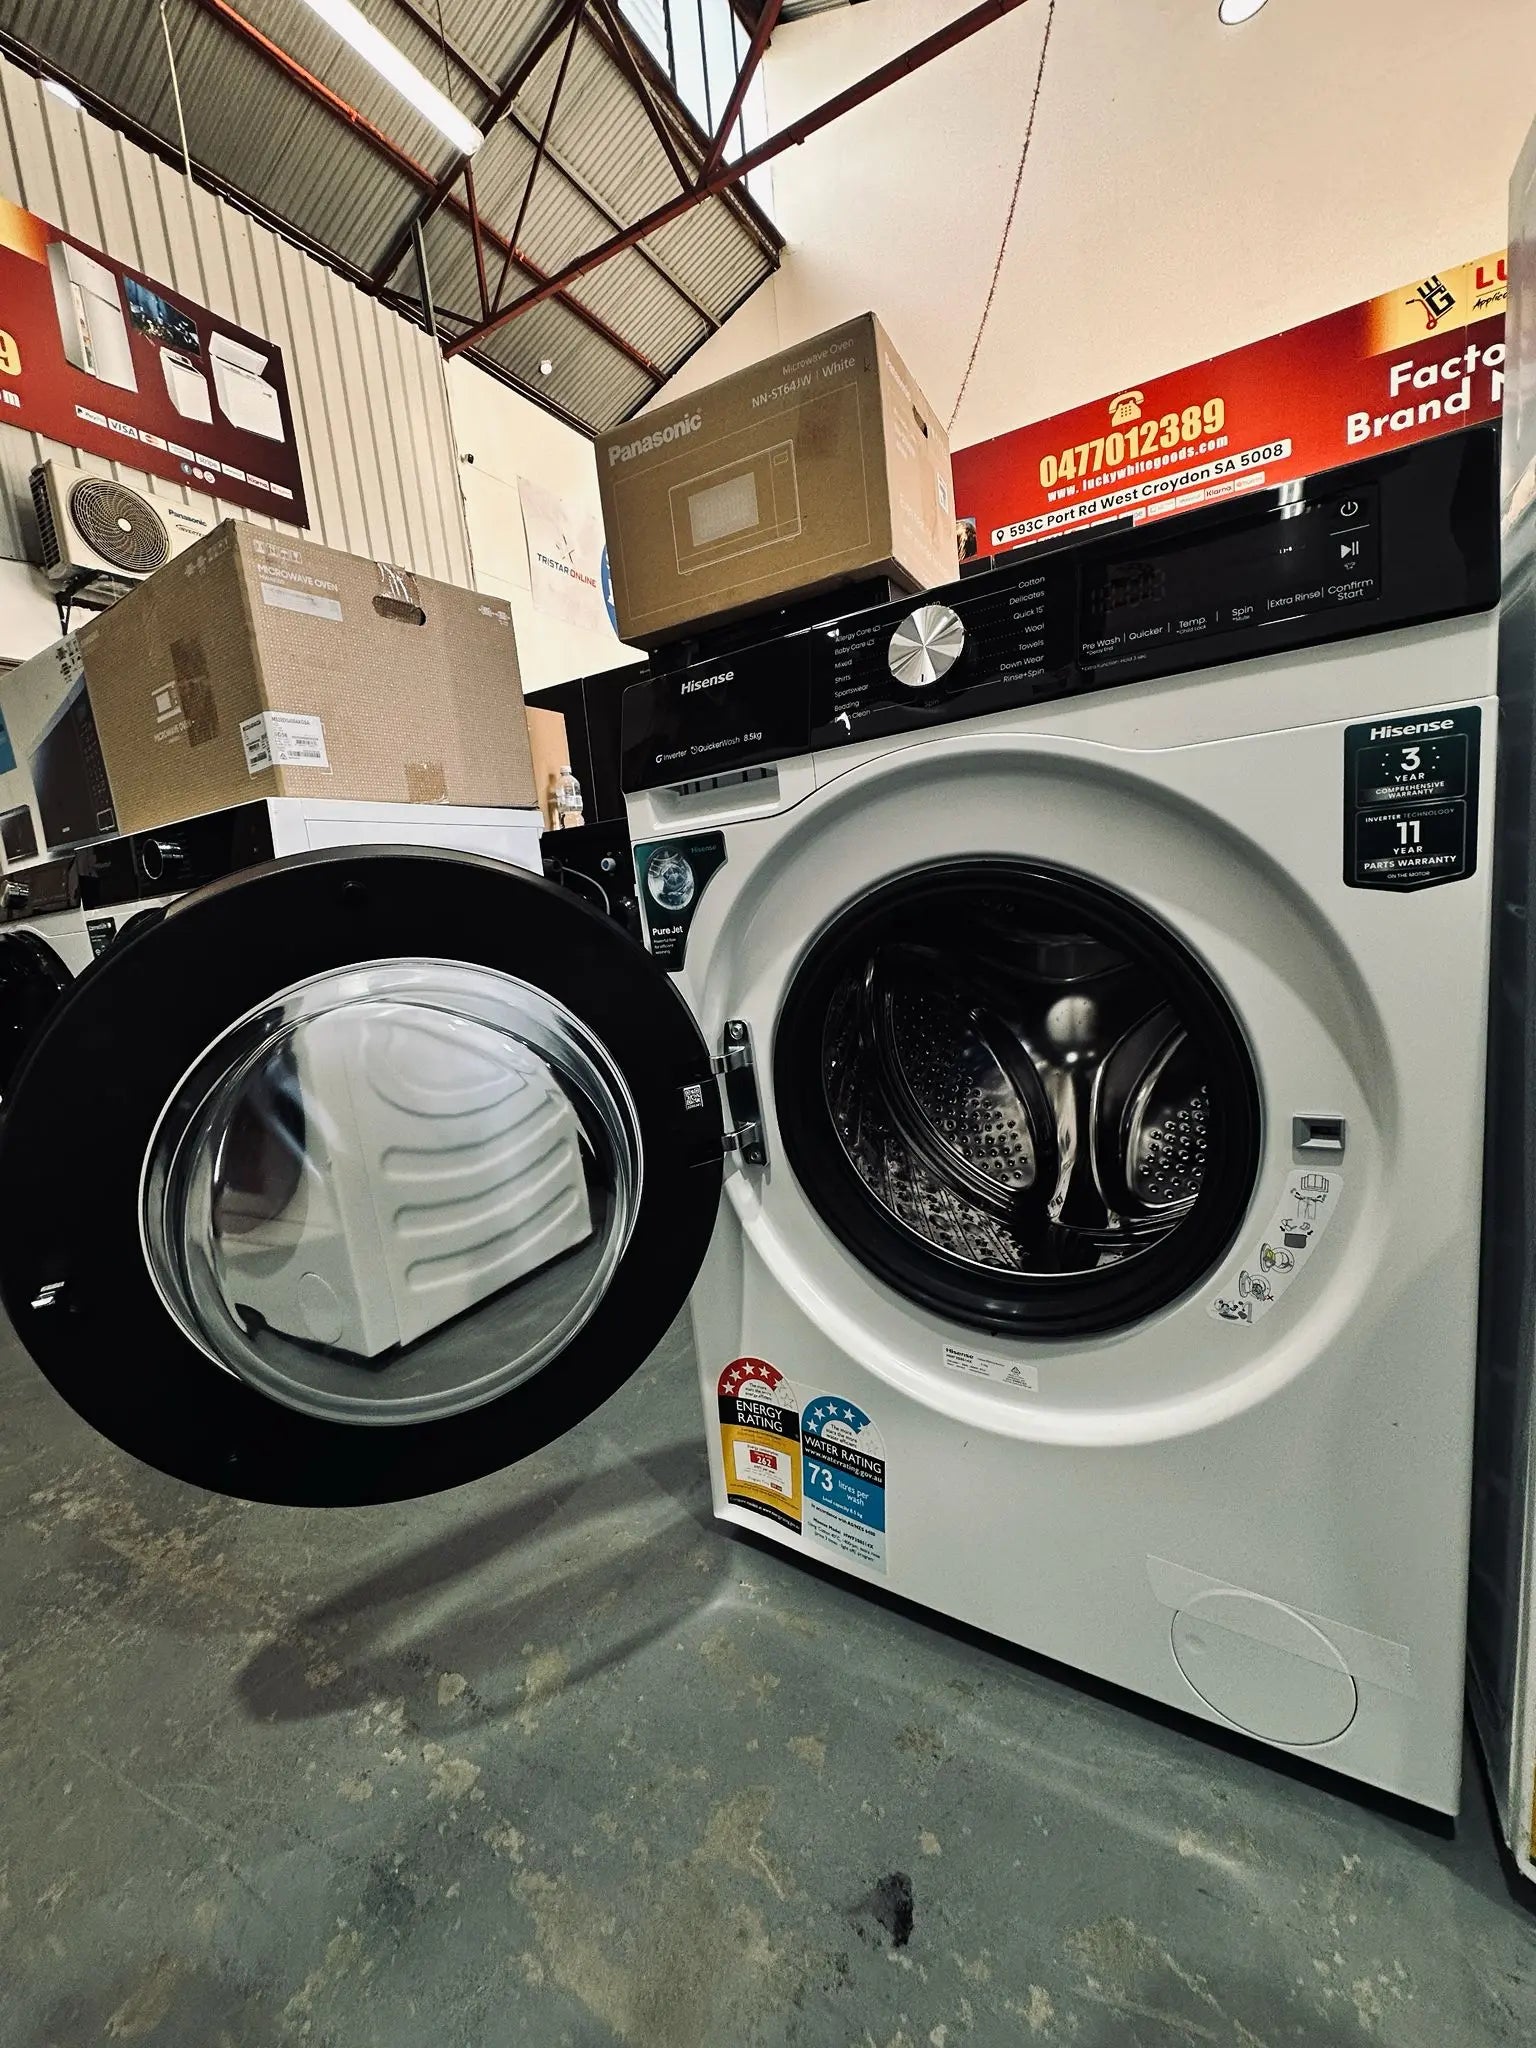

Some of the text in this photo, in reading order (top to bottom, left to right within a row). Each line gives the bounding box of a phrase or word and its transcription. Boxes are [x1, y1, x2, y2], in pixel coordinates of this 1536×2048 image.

[782, 338, 854, 375] Microwave Oven
[751, 373, 812, 408] NN-ST64JW
[821, 357, 856, 377] White
[1347, 376, 1471, 445] Brand
[111, 421, 136, 437] VISA
[608, 410, 703, 466] Panasonic
[1039, 398, 1225, 488] 0477012389
[1082, 434, 1229, 492] luckywhitegoods.com
[1009, 518, 1043, 538] 593C
[1047, 509, 1075, 526] Port
[1079, 501, 1098, 516] Rd
[1101, 489, 1138, 510] West
[1142, 469, 1210, 498] Croydon
[1214, 462, 1236, 479] SA
[1240, 443, 1284, 466] 5008
[168, 508, 208, 527] Panasonic
[257, 563, 314, 586] MICROWAVE
[314, 579, 338, 592] OVEN
[537, 552, 597, 588] TRISTAR ONLINE
[1018, 576, 1046, 590] Cotton
[1327, 578, 1374, 595] Confirm
[1009, 590, 1045, 606] Delicates
[1270, 590, 1321, 609] Extra Rinse
[1337, 588, 1364, 601] Start
[1013, 608, 1033, 621] Quick
[1232, 604, 1254, 618] Spin
[1024, 622, 1045, 634] Wool
[1178, 616, 1208, 629] Temp.
[1128, 625, 1163, 641] Quicker
[834, 641, 866, 656] Baby Care
[1018, 639, 1045, 652] Towels
[1082, 635, 1121, 651] Pre Wash
[834, 659, 853, 669] Mixed
[1000, 654, 1045, 671] Down Wear
[680, 670, 734, 695] Hisense
[834, 674, 851, 684] Shirts
[1003, 667, 1045, 684] Rinse+Spin
[834, 684, 869, 698] Sportswear
[834, 701, 860, 712] Bedding
[852, 709, 871, 719] Clean
[1370, 719, 1454, 740] Hisense
[663, 731, 762, 761] Inverter QuickerWash 8.5kg
[1400, 746, 1421, 771] 3
[1394, 772, 1425, 783] YEAR
[1375, 780, 1445, 795] COMPREHENSIVE
[1388, 788, 1434, 799] WARRANTY
[1365, 808, 1455, 823] INVERTER TECHNOLOGY
[1396, 820, 1421, 845] 11
[1393, 845, 1423, 855] YEAR
[1364, 855, 1457, 870] PARTS WARRANTY
[1408, 870, 1431, 878] MOTOR
[652, 925, 684, 936] Pure Jet
[945, 1348, 974, 1360] Hisense
[735, 1399, 782, 1420] ENERGY
[737, 1412, 783, 1433] RATING
[830, 1423, 852, 1436] The more
[756, 1455, 772, 1467] 262
[804, 1435, 838, 1456] WATER
[841, 1449, 882, 1474] RATING
[804, 1447, 883, 1483] www.waterrating.gov.au
[808, 1462, 833, 1492] 73
[838, 1480, 870, 1500] litres per
[847, 1494, 865, 1507] wash
